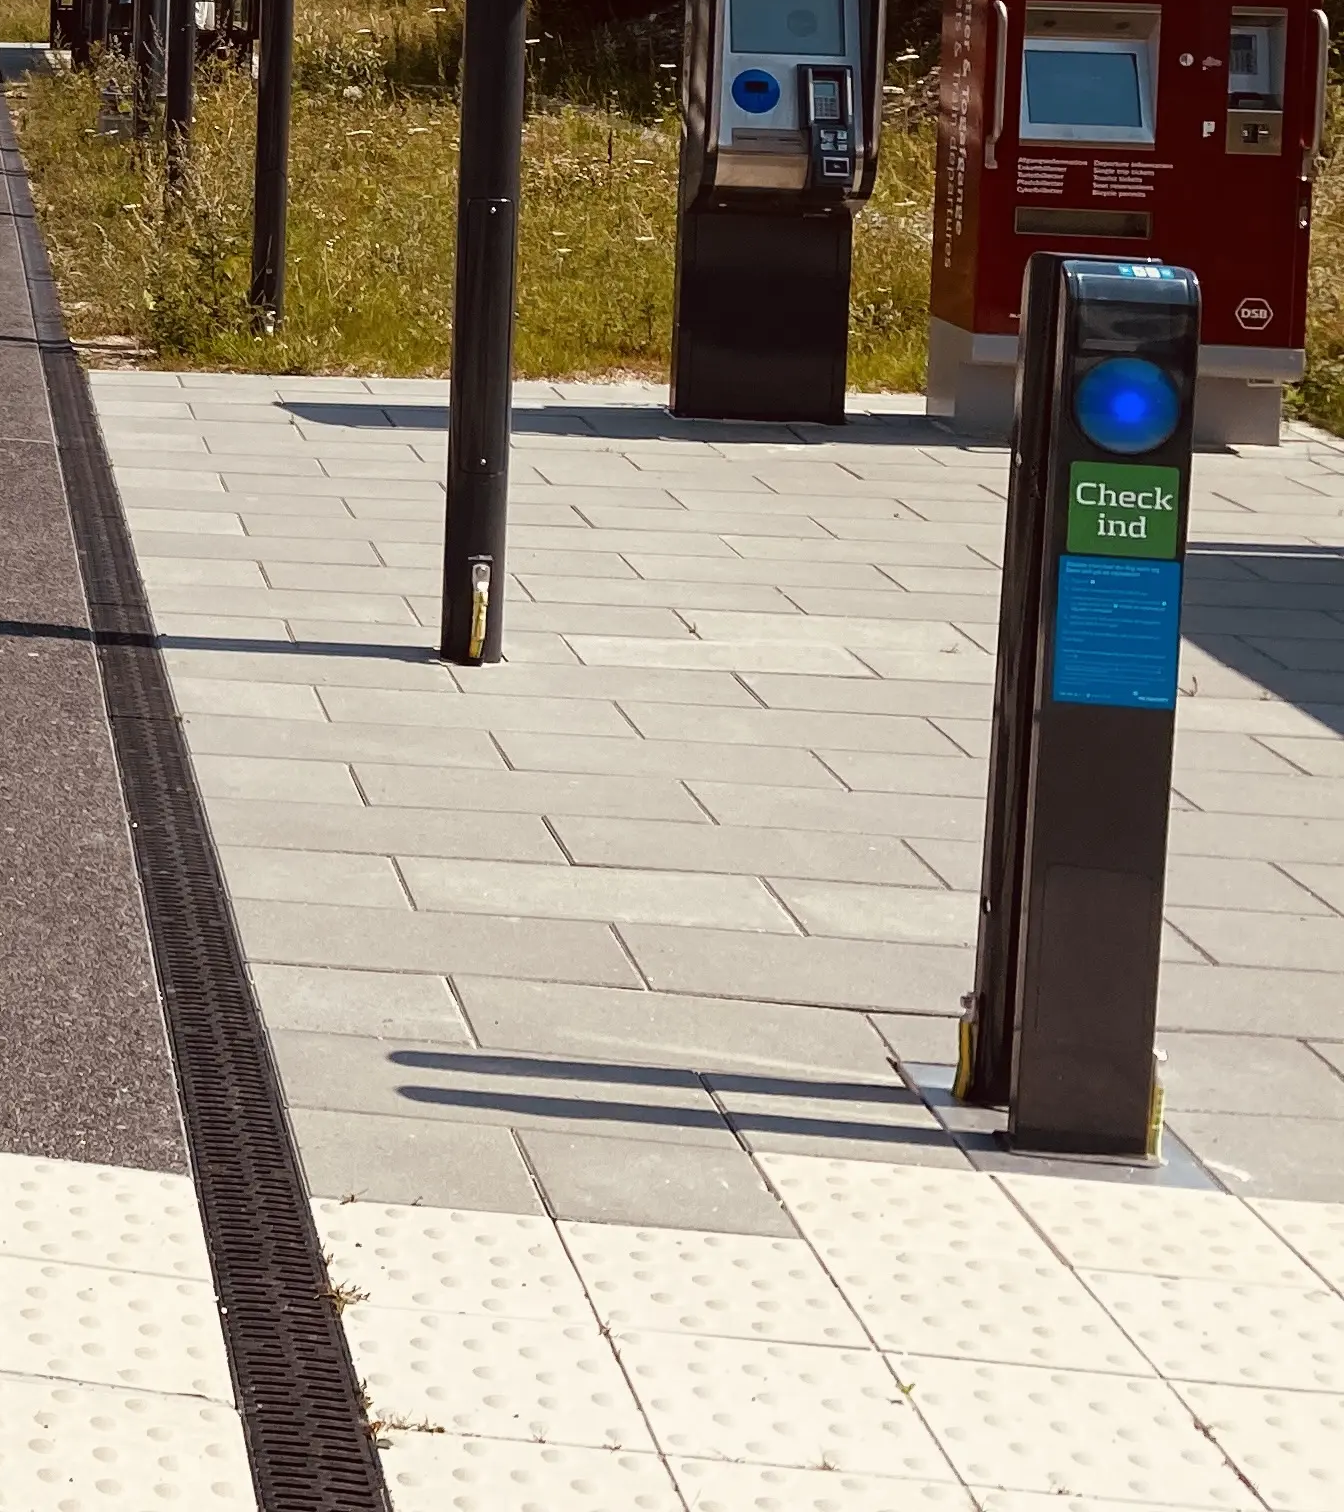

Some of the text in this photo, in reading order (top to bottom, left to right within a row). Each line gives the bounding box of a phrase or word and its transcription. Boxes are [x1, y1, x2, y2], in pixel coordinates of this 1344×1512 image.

[1240, 308, 1268, 319] DSB
[1075, 482, 1174, 511] Check
[1097, 512, 1148, 539] ind
